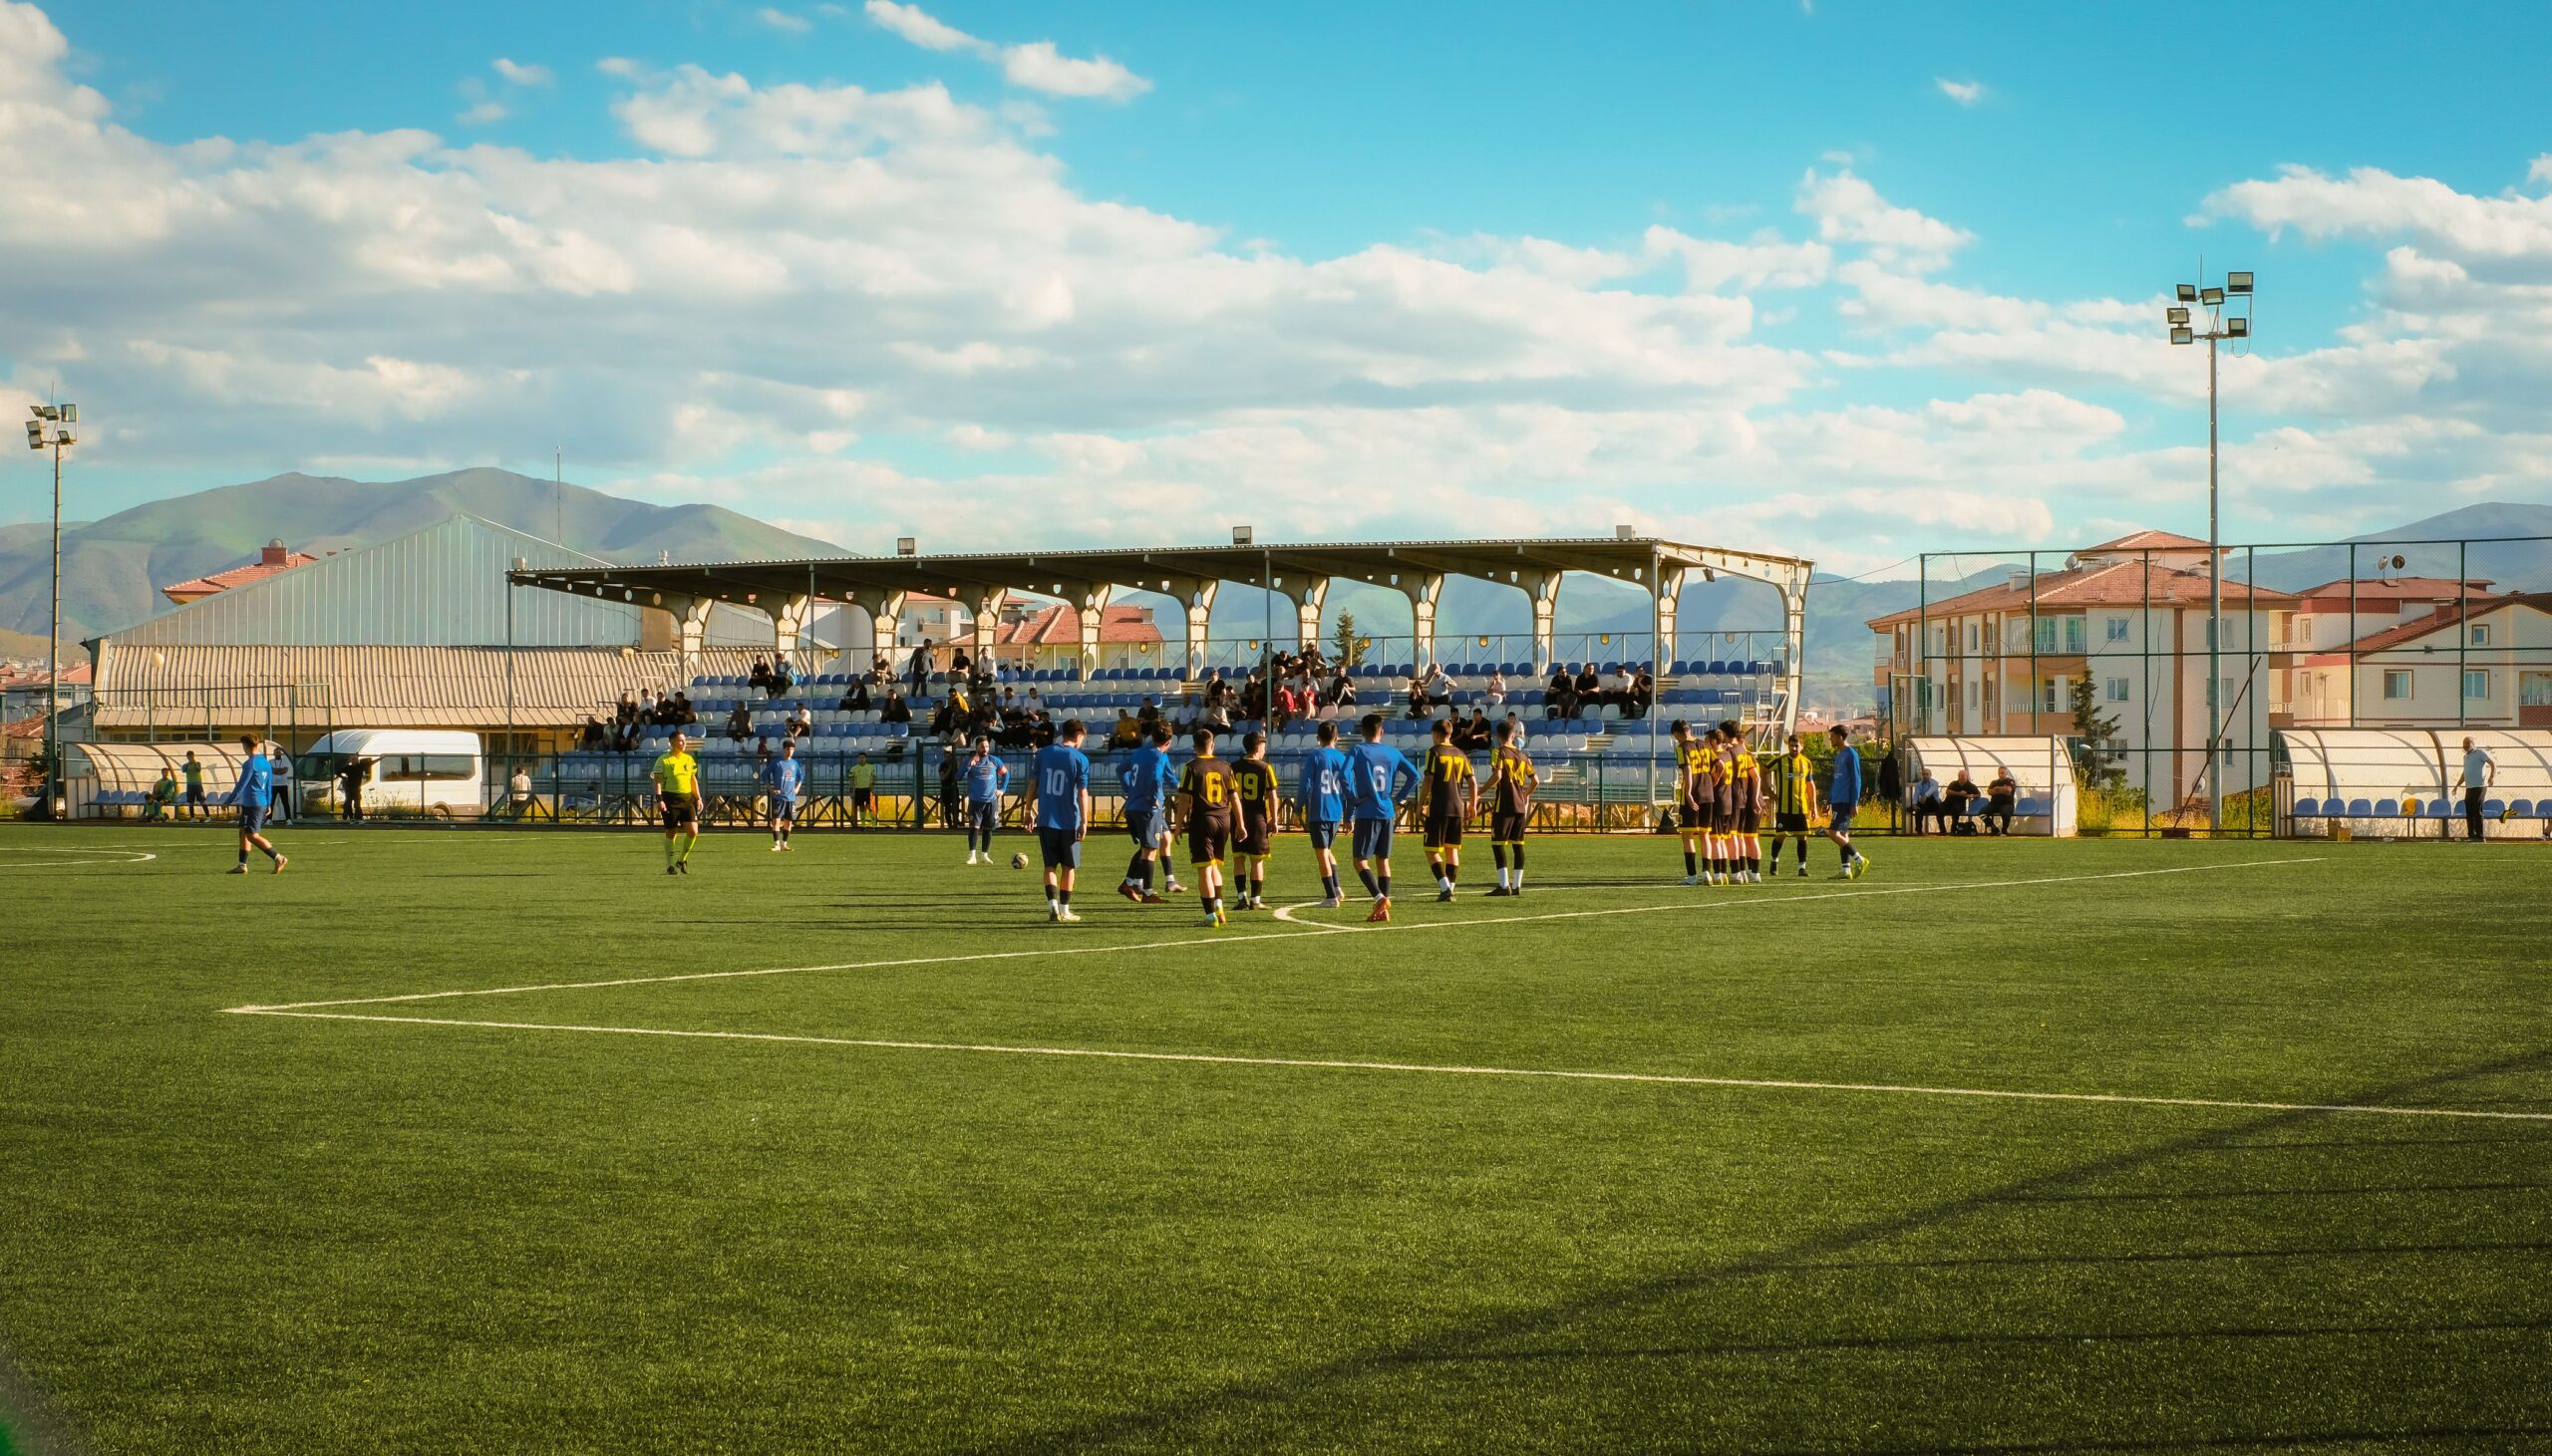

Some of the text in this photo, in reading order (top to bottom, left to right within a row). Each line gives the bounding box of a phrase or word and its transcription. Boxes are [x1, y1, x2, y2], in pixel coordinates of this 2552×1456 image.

[1130, 763, 1139, 787] 3
[1438, 755, 1464, 783] 77
[1689, 748, 1711, 774] 23
[1046, 767, 1066, 796] 10
[1205, 771, 1222, 804] 6
[1372, 764, 1386, 792] 6
